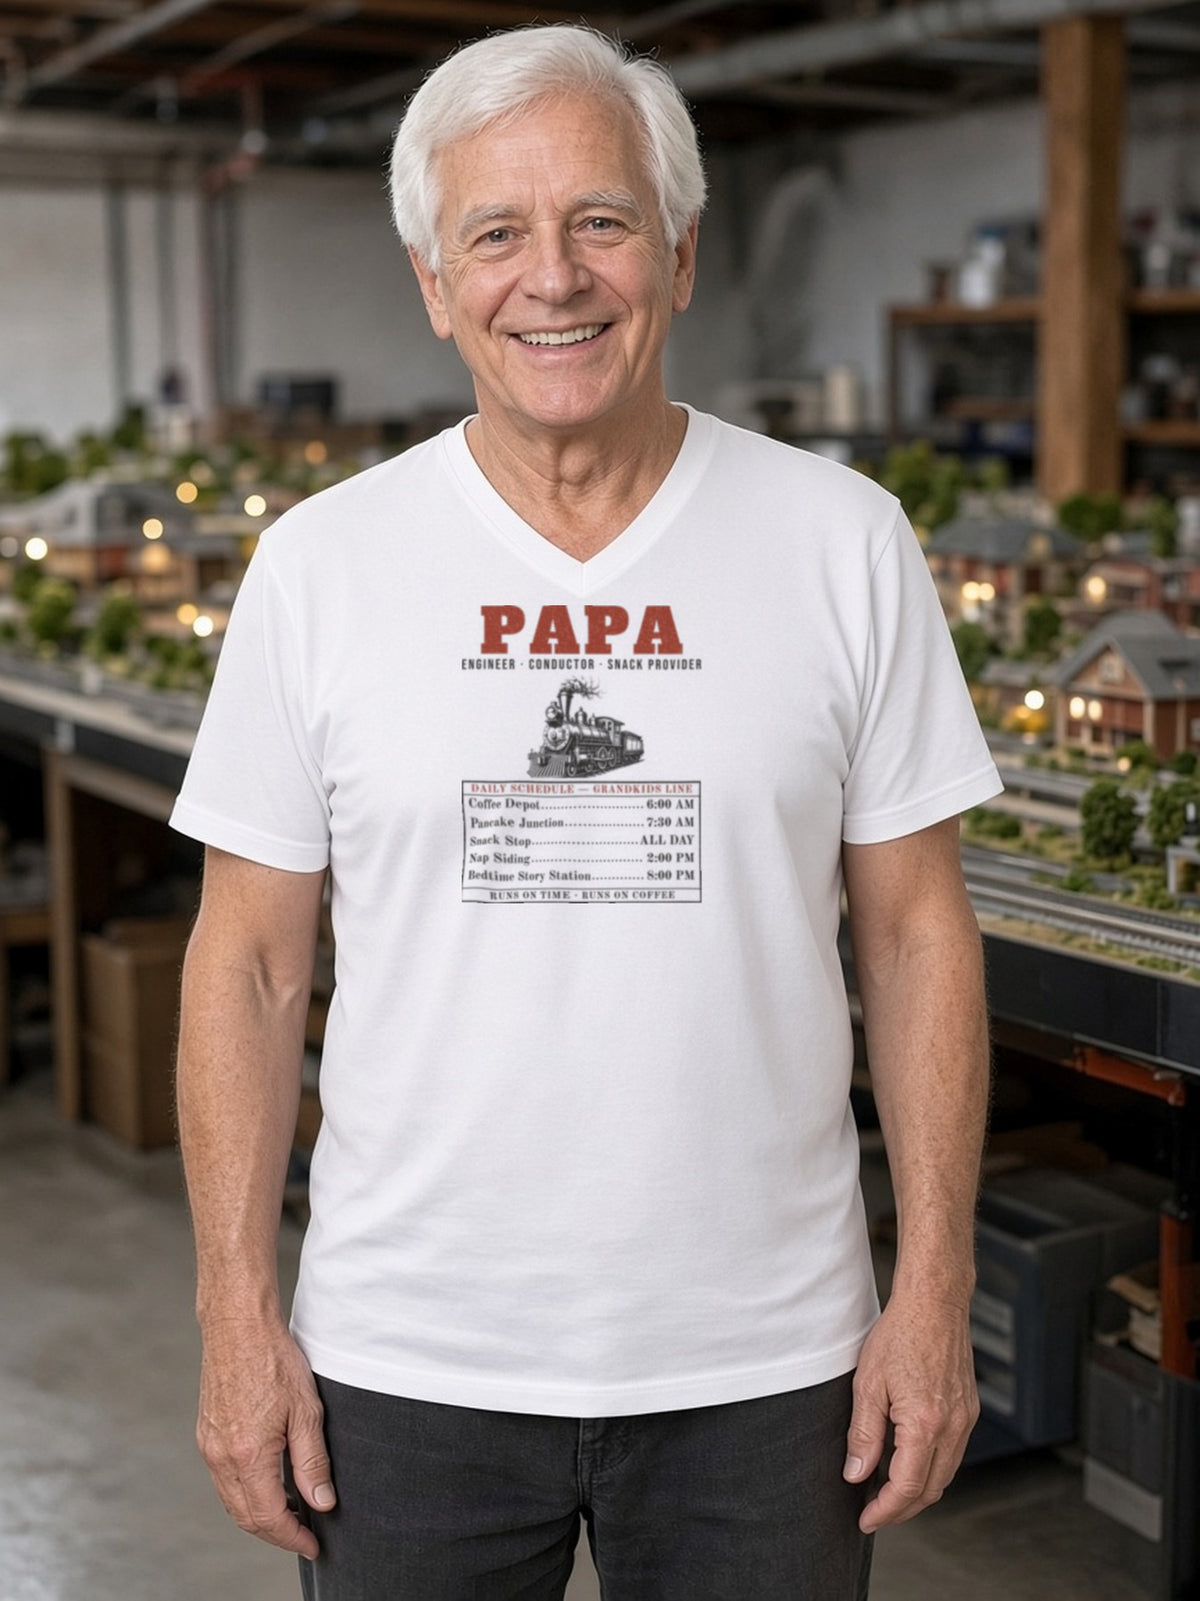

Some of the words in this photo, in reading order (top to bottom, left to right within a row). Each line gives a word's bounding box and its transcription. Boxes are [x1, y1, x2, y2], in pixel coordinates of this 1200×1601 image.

[481, 605, 683, 654] PAPA
[462, 659, 515, 670] ENGINEER
[529, 659, 594, 670] CONDUCTOR
[608, 659, 643, 670] SNACK
[648, 659, 702, 670] PROVIDER
[471, 784, 505, 793] DAILY
[510, 784, 574, 793] SCHEDULE
[593, 784, 662, 793] GRANDKIDS
[665, 784, 693, 793] LINE
[468, 797, 501, 809] Coffee
[646, 799, 672, 809] 6:00
[675, 799, 695, 809] AM
[470, 817, 515, 829] Pancake
[646, 817, 672, 828] 7:30
[675, 817, 695, 828] AM
[469, 835, 500, 846] Snack
[640, 835, 666, 846] ALL
[670, 835, 695, 846] DAY
[469, 853, 489, 864] Nap
[646, 852, 672, 863] 2:00
[676, 852, 695, 863] PM
[468, 870, 514, 882] Bedtime
[518, 870, 545, 883] Story
[646, 870, 672, 881] 8:00
[676, 870, 695, 881] PM
[490, 891, 519, 900] RUNS
[522, 891, 536, 900] ON
[541, 891, 570, 899] TIME
[582, 891, 611, 899] RUNS
[614, 891, 629, 899] ON
[632, 891, 675, 899] COFFEE
